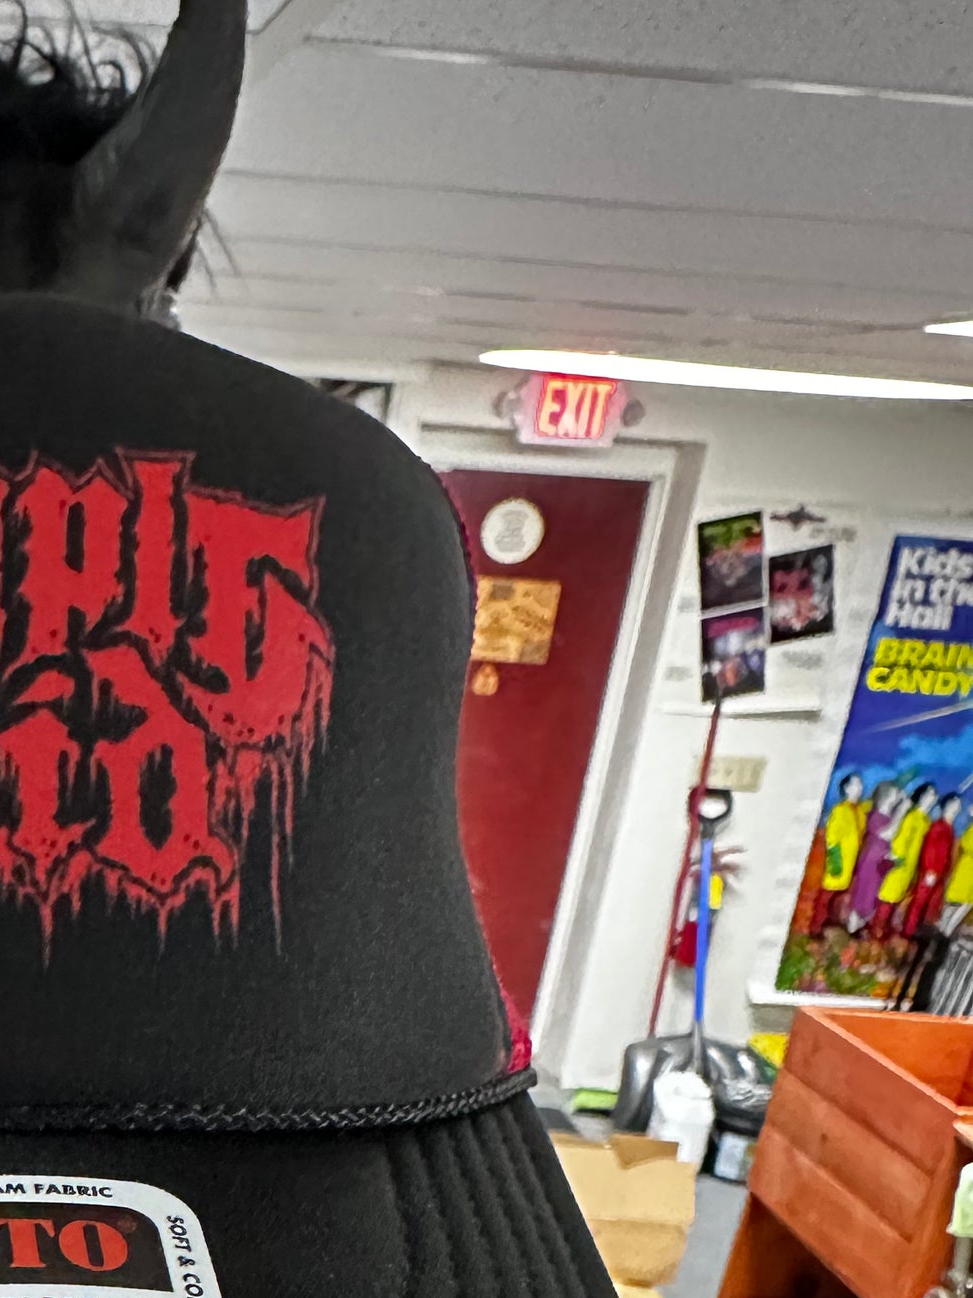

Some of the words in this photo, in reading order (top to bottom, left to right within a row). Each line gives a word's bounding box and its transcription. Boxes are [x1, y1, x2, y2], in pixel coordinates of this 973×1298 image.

[538, 380, 614, 436] EXIT
[898, 547, 973, 578] Kids
[885, 603, 953, 630] Hall
[876, 637, 973, 670] BRAIN
[866, 667, 973, 697] CANDY
[34, 1183, 113, 1199] FABRIC
[166, 1215, 192, 1252] SOFT
[178, 1256, 196, 1267] &
